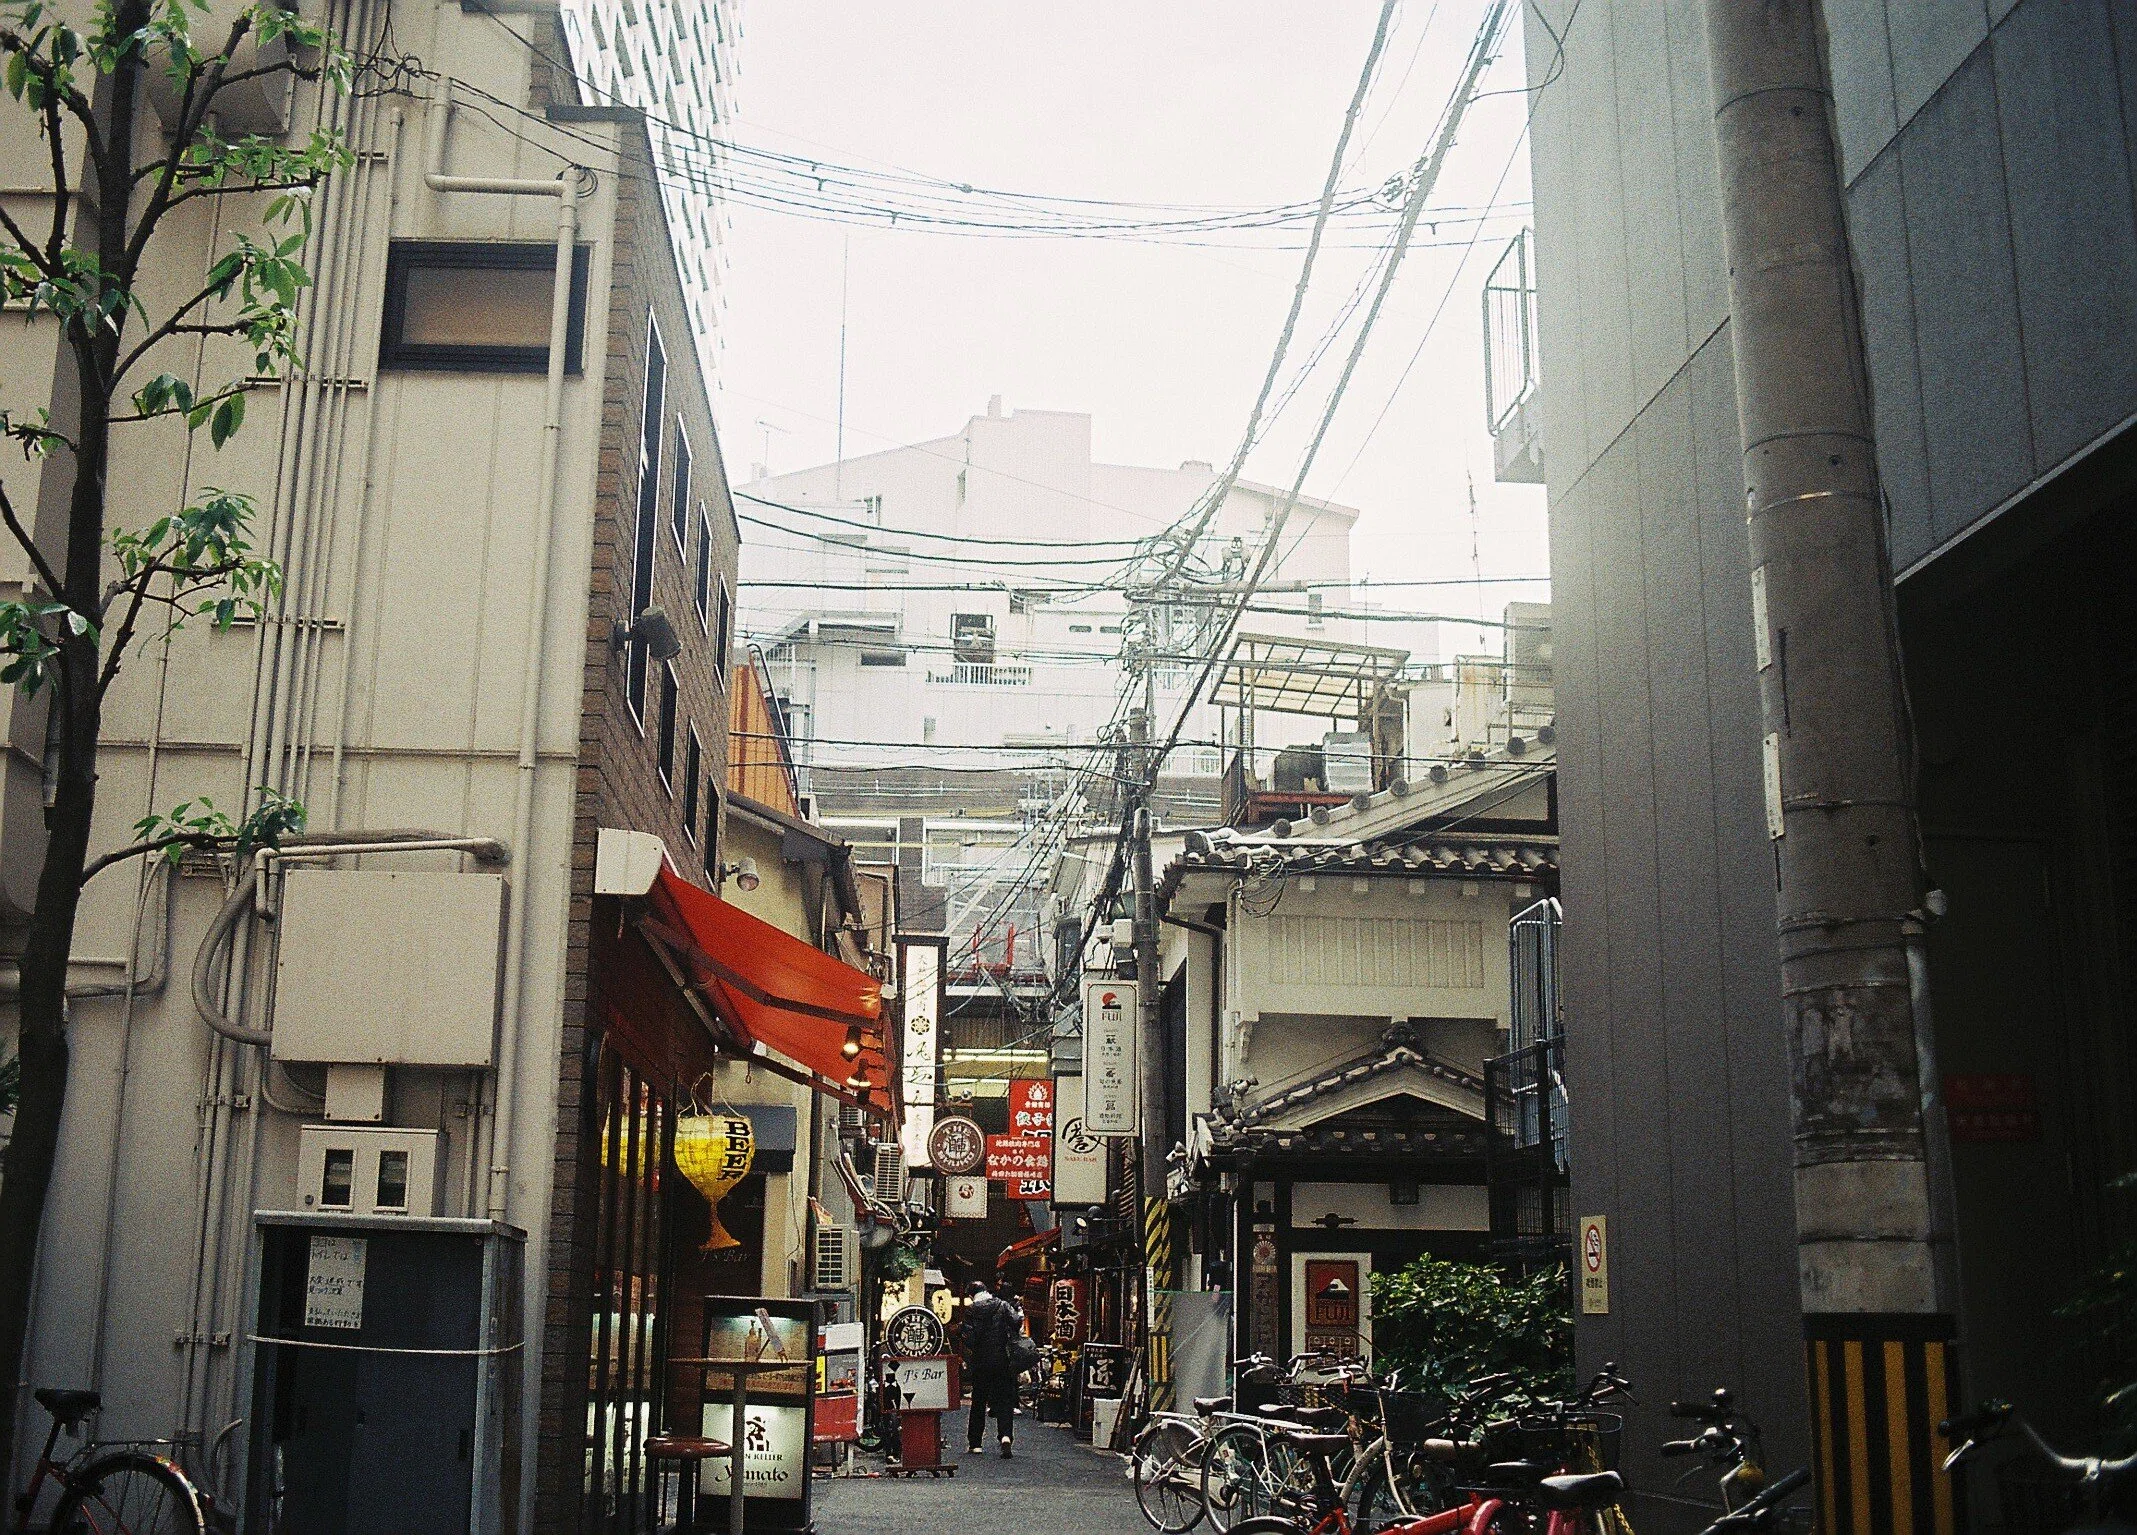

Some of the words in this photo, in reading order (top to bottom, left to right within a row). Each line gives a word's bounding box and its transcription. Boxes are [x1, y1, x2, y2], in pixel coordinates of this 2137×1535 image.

[1101, 1012, 1122, 1022] FUJI
[941, 1125, 973, 1137] THE
[717, 1120, 750, 1182] BEER
[1055, 1284, 1080, 1340] 日本酒
[1315, 1305, 1350, 1320] FUJI
[900, 1314, 931, 1327] THE
[921, 1367, 945, 1380] Bar
